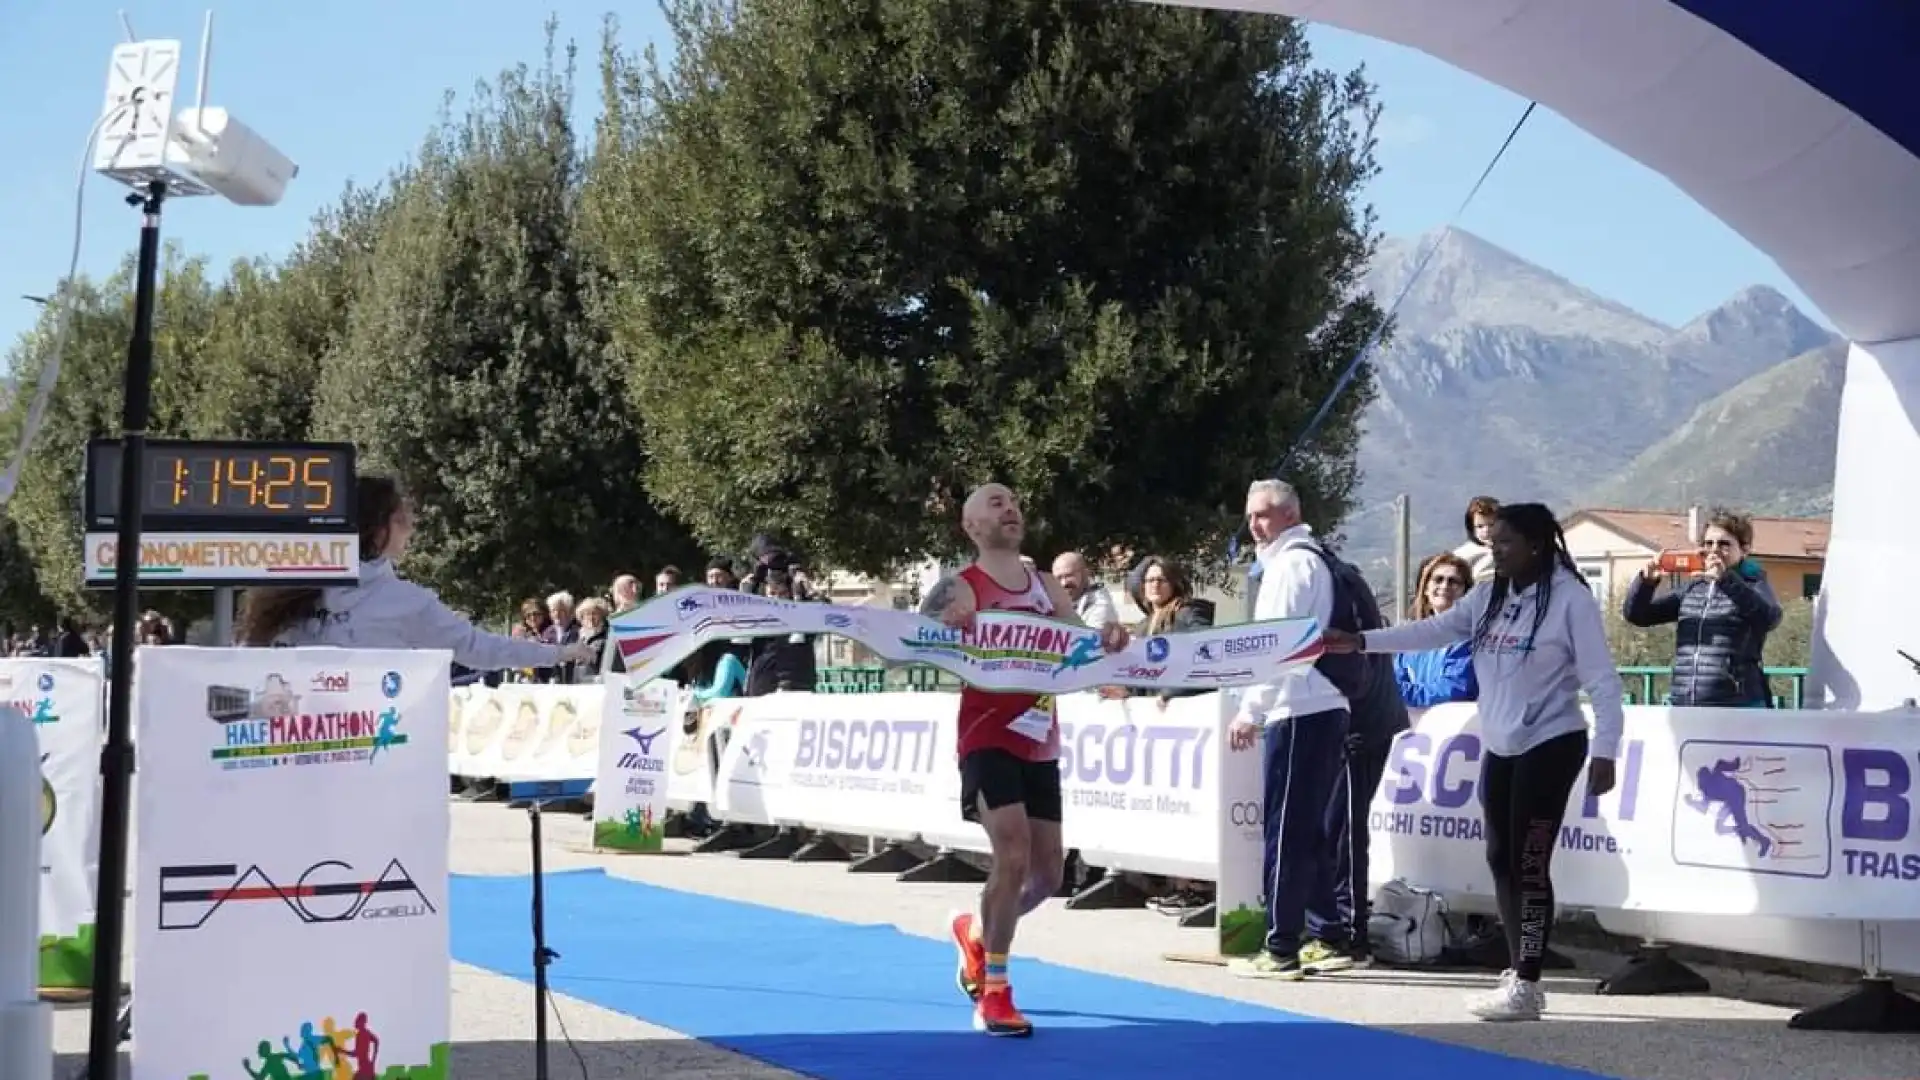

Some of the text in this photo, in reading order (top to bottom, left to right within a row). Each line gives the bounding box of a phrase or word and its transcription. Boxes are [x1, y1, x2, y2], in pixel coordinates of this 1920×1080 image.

[172, 456, 332, 510] 1:14:25
[96, 541, 349, 568] CNOMETROGARA.IT
[1224, 632, 1279, 654] BISCOTTI
[226, 710, 375, 745] HALF MARATHON
[795, 719, 939, 773] BISCOTTI
[1071, 788, 1127, 810] STORAGE
[1131, 796, 1154, 811] and
[1842, 748, 1920, 842] B
[1371, 811, 1414, 836] OCHI
[1420, 815, 1483, 840] STORA
